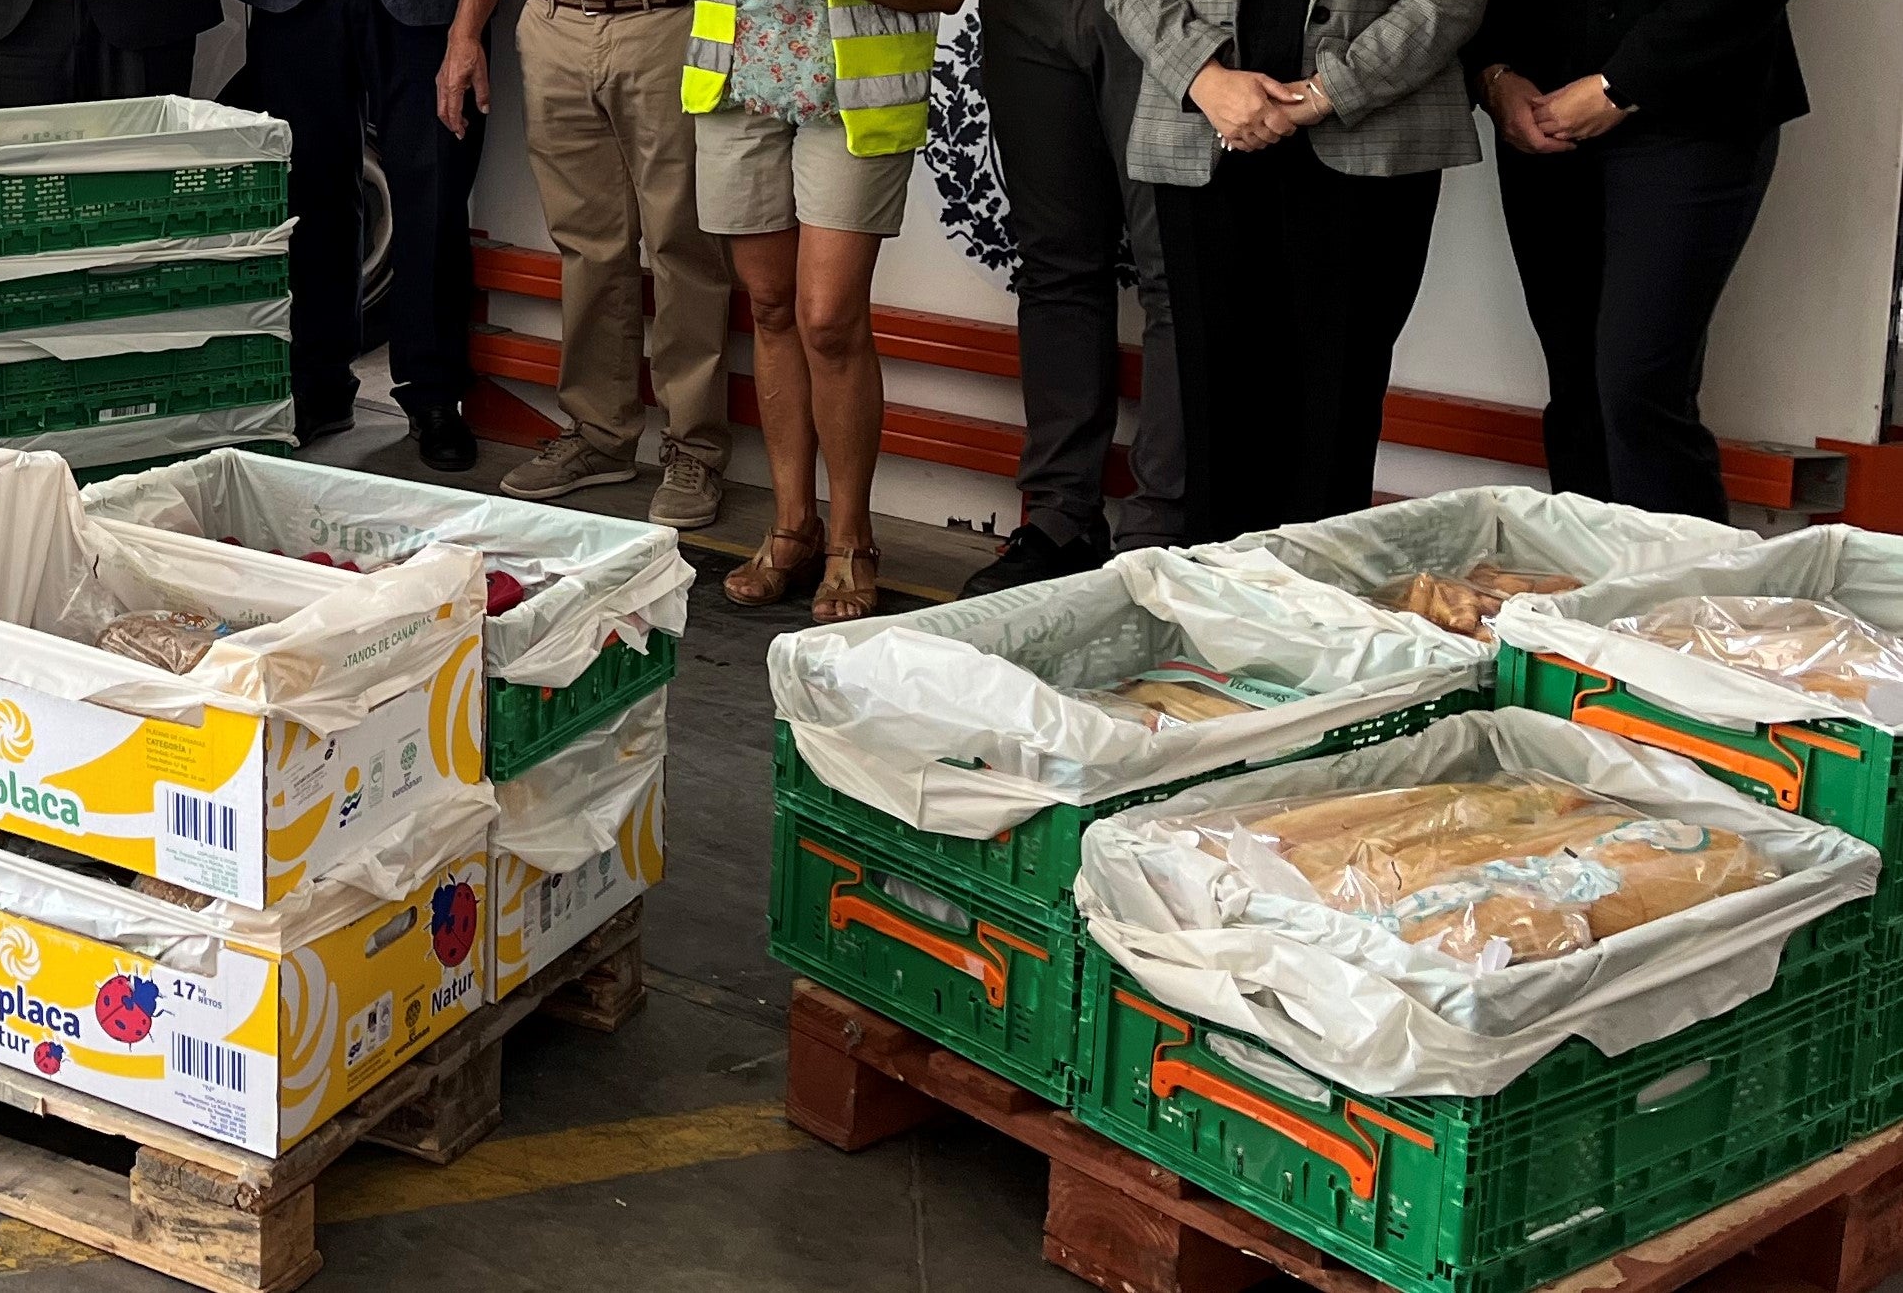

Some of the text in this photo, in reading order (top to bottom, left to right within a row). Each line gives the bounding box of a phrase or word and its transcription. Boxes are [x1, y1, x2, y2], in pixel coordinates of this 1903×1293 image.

[378, 637, 390, 654] DE
[173, 979, 196, 1001] 17
[197, 985, 207, 998] kg
[432, 970, 475, 1017] Natur
[198, 996, 222, 1011] NETOS
